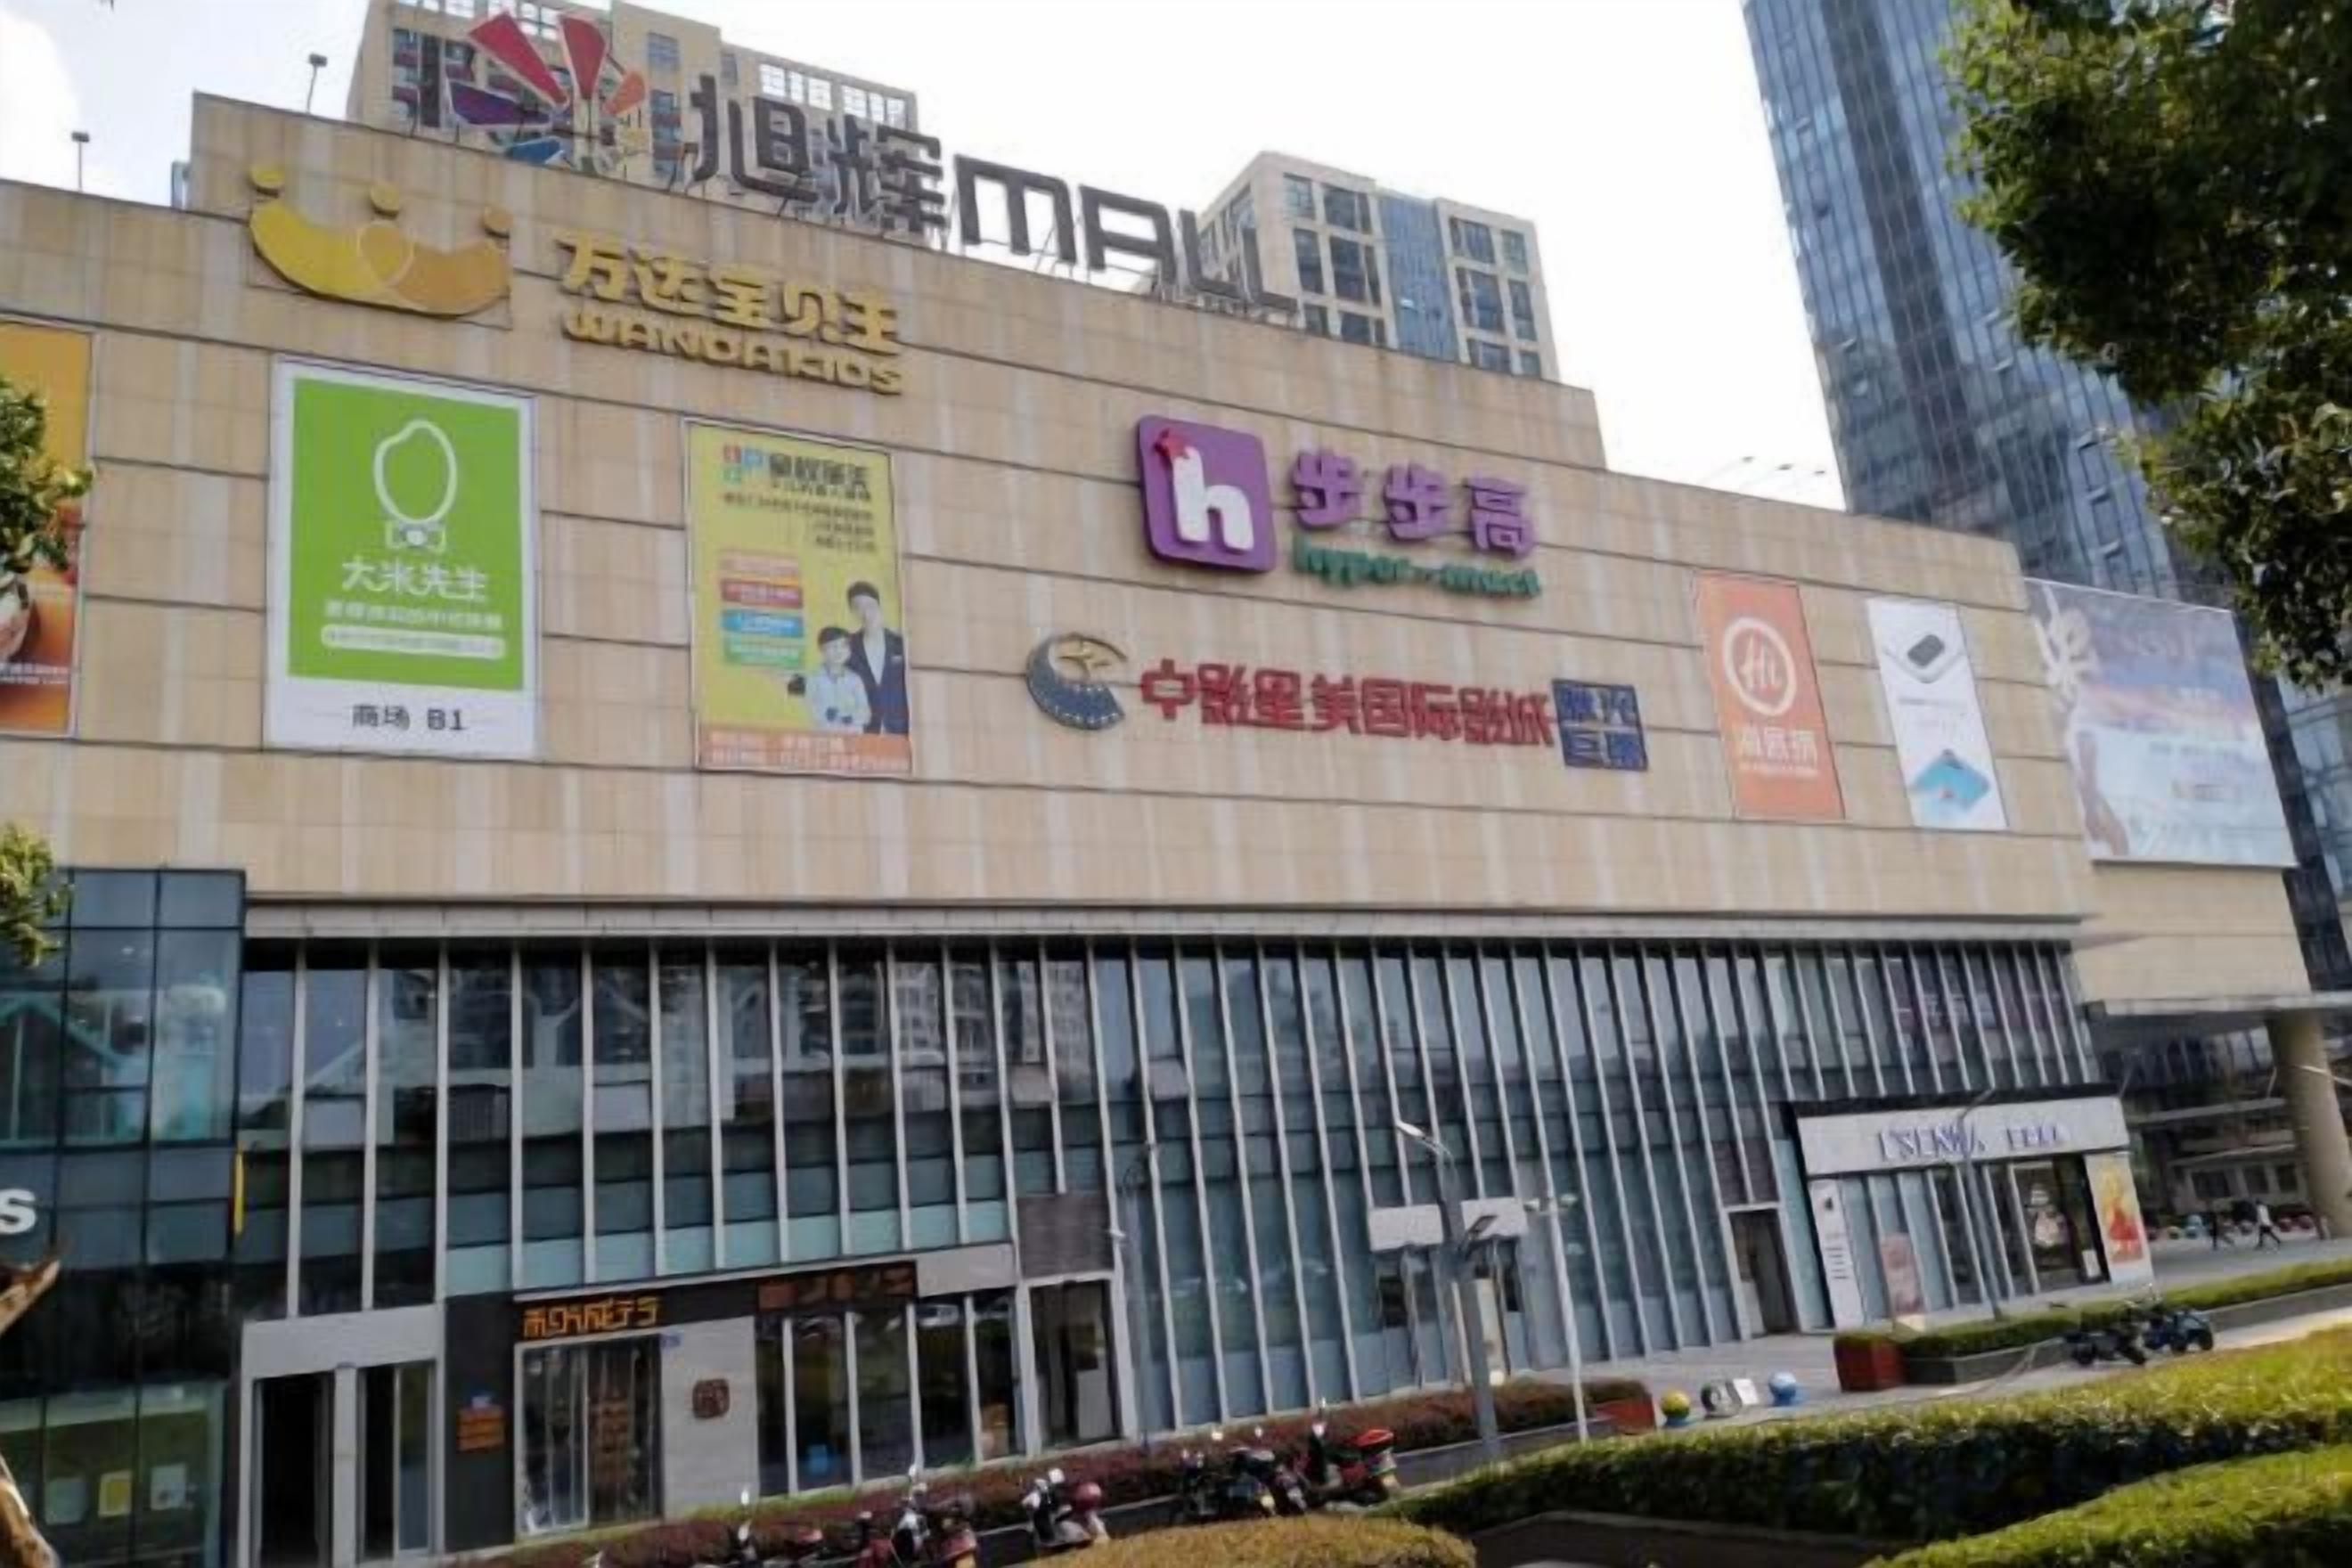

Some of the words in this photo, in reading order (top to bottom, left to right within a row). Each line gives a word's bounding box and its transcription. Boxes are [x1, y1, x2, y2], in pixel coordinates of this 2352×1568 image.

[555, 228, 903, 355] 万达宝贝王
[1291, 450, 1536, 559] 步步高
[341, 554, 487, 603] 大米先生
[352, 704, 410, 732] 商场
[427, 707, 466, 731] B1
[1140, 658, 1554, 747] 中影星美国际影城
